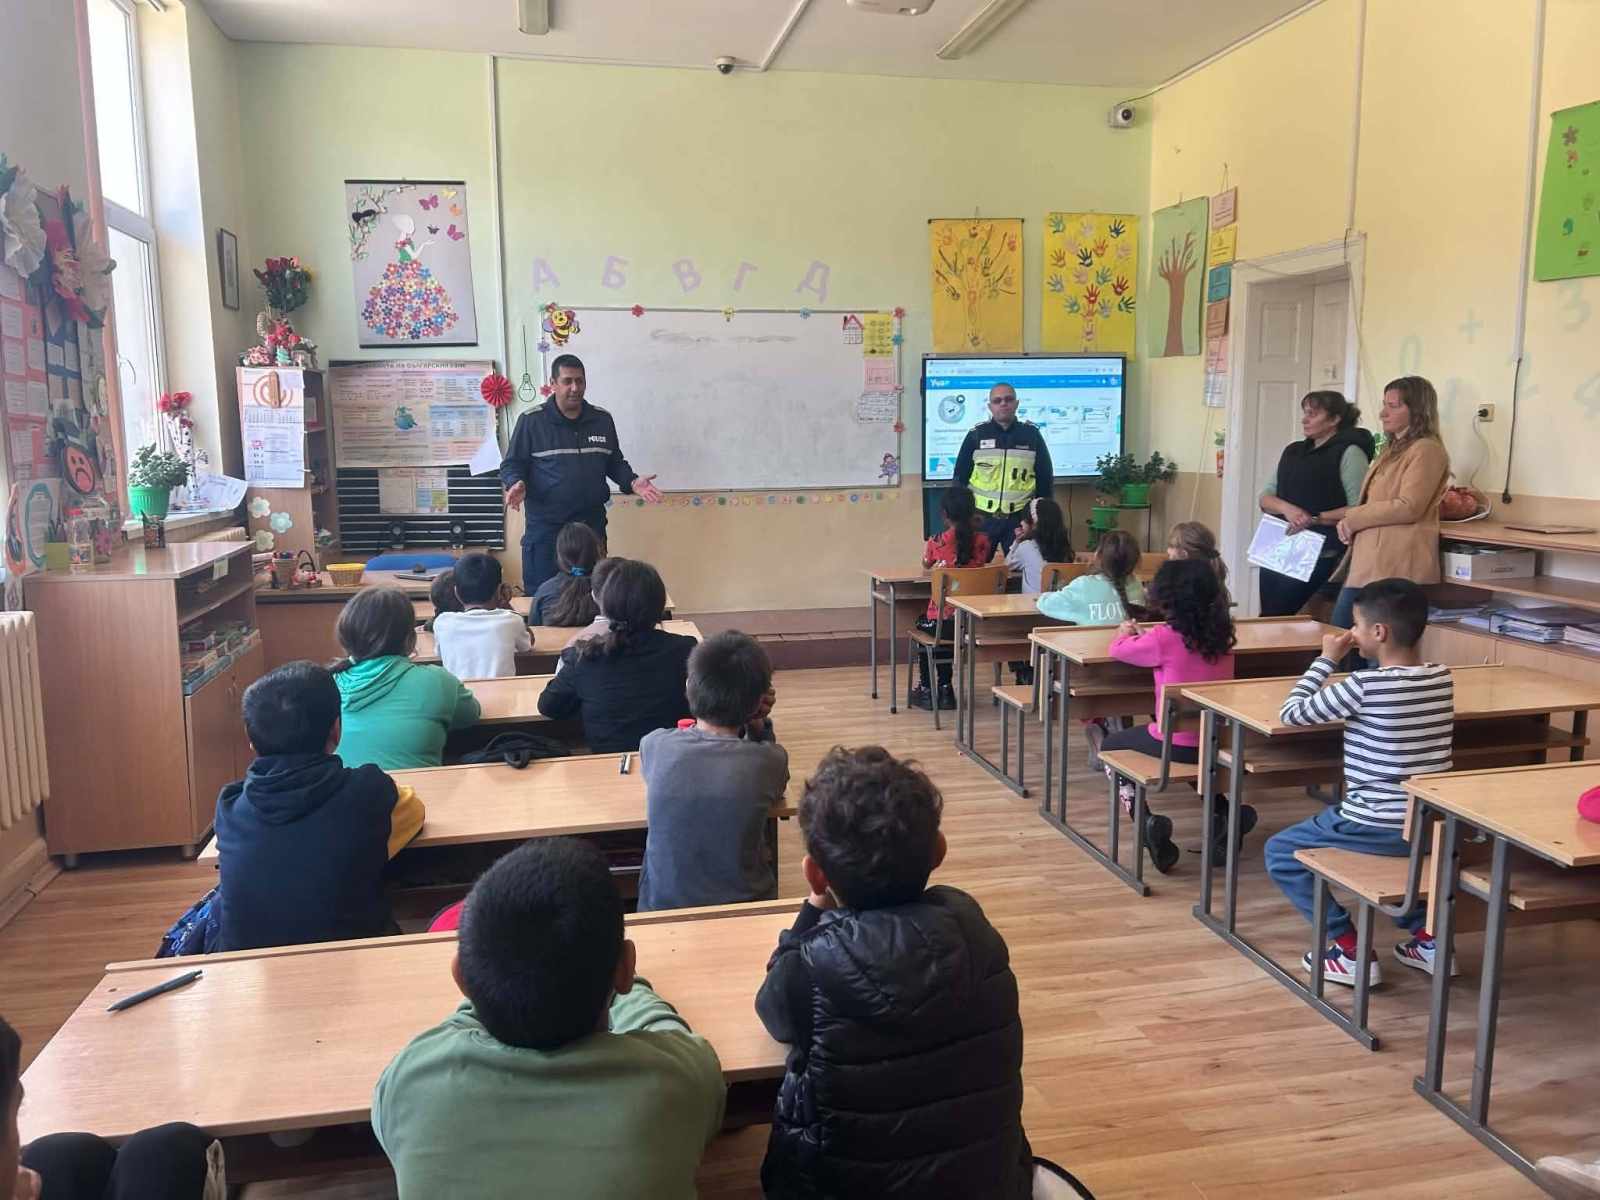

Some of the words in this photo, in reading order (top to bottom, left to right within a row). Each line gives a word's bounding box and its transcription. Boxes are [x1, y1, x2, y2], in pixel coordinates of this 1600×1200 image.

[531, 256, 560, 292] А
[601, 255, 628, 289] Б
[672, 258, 702, 293] В
[734, 261, 758, 291] Г
[794, 260, 832, 304] Д
